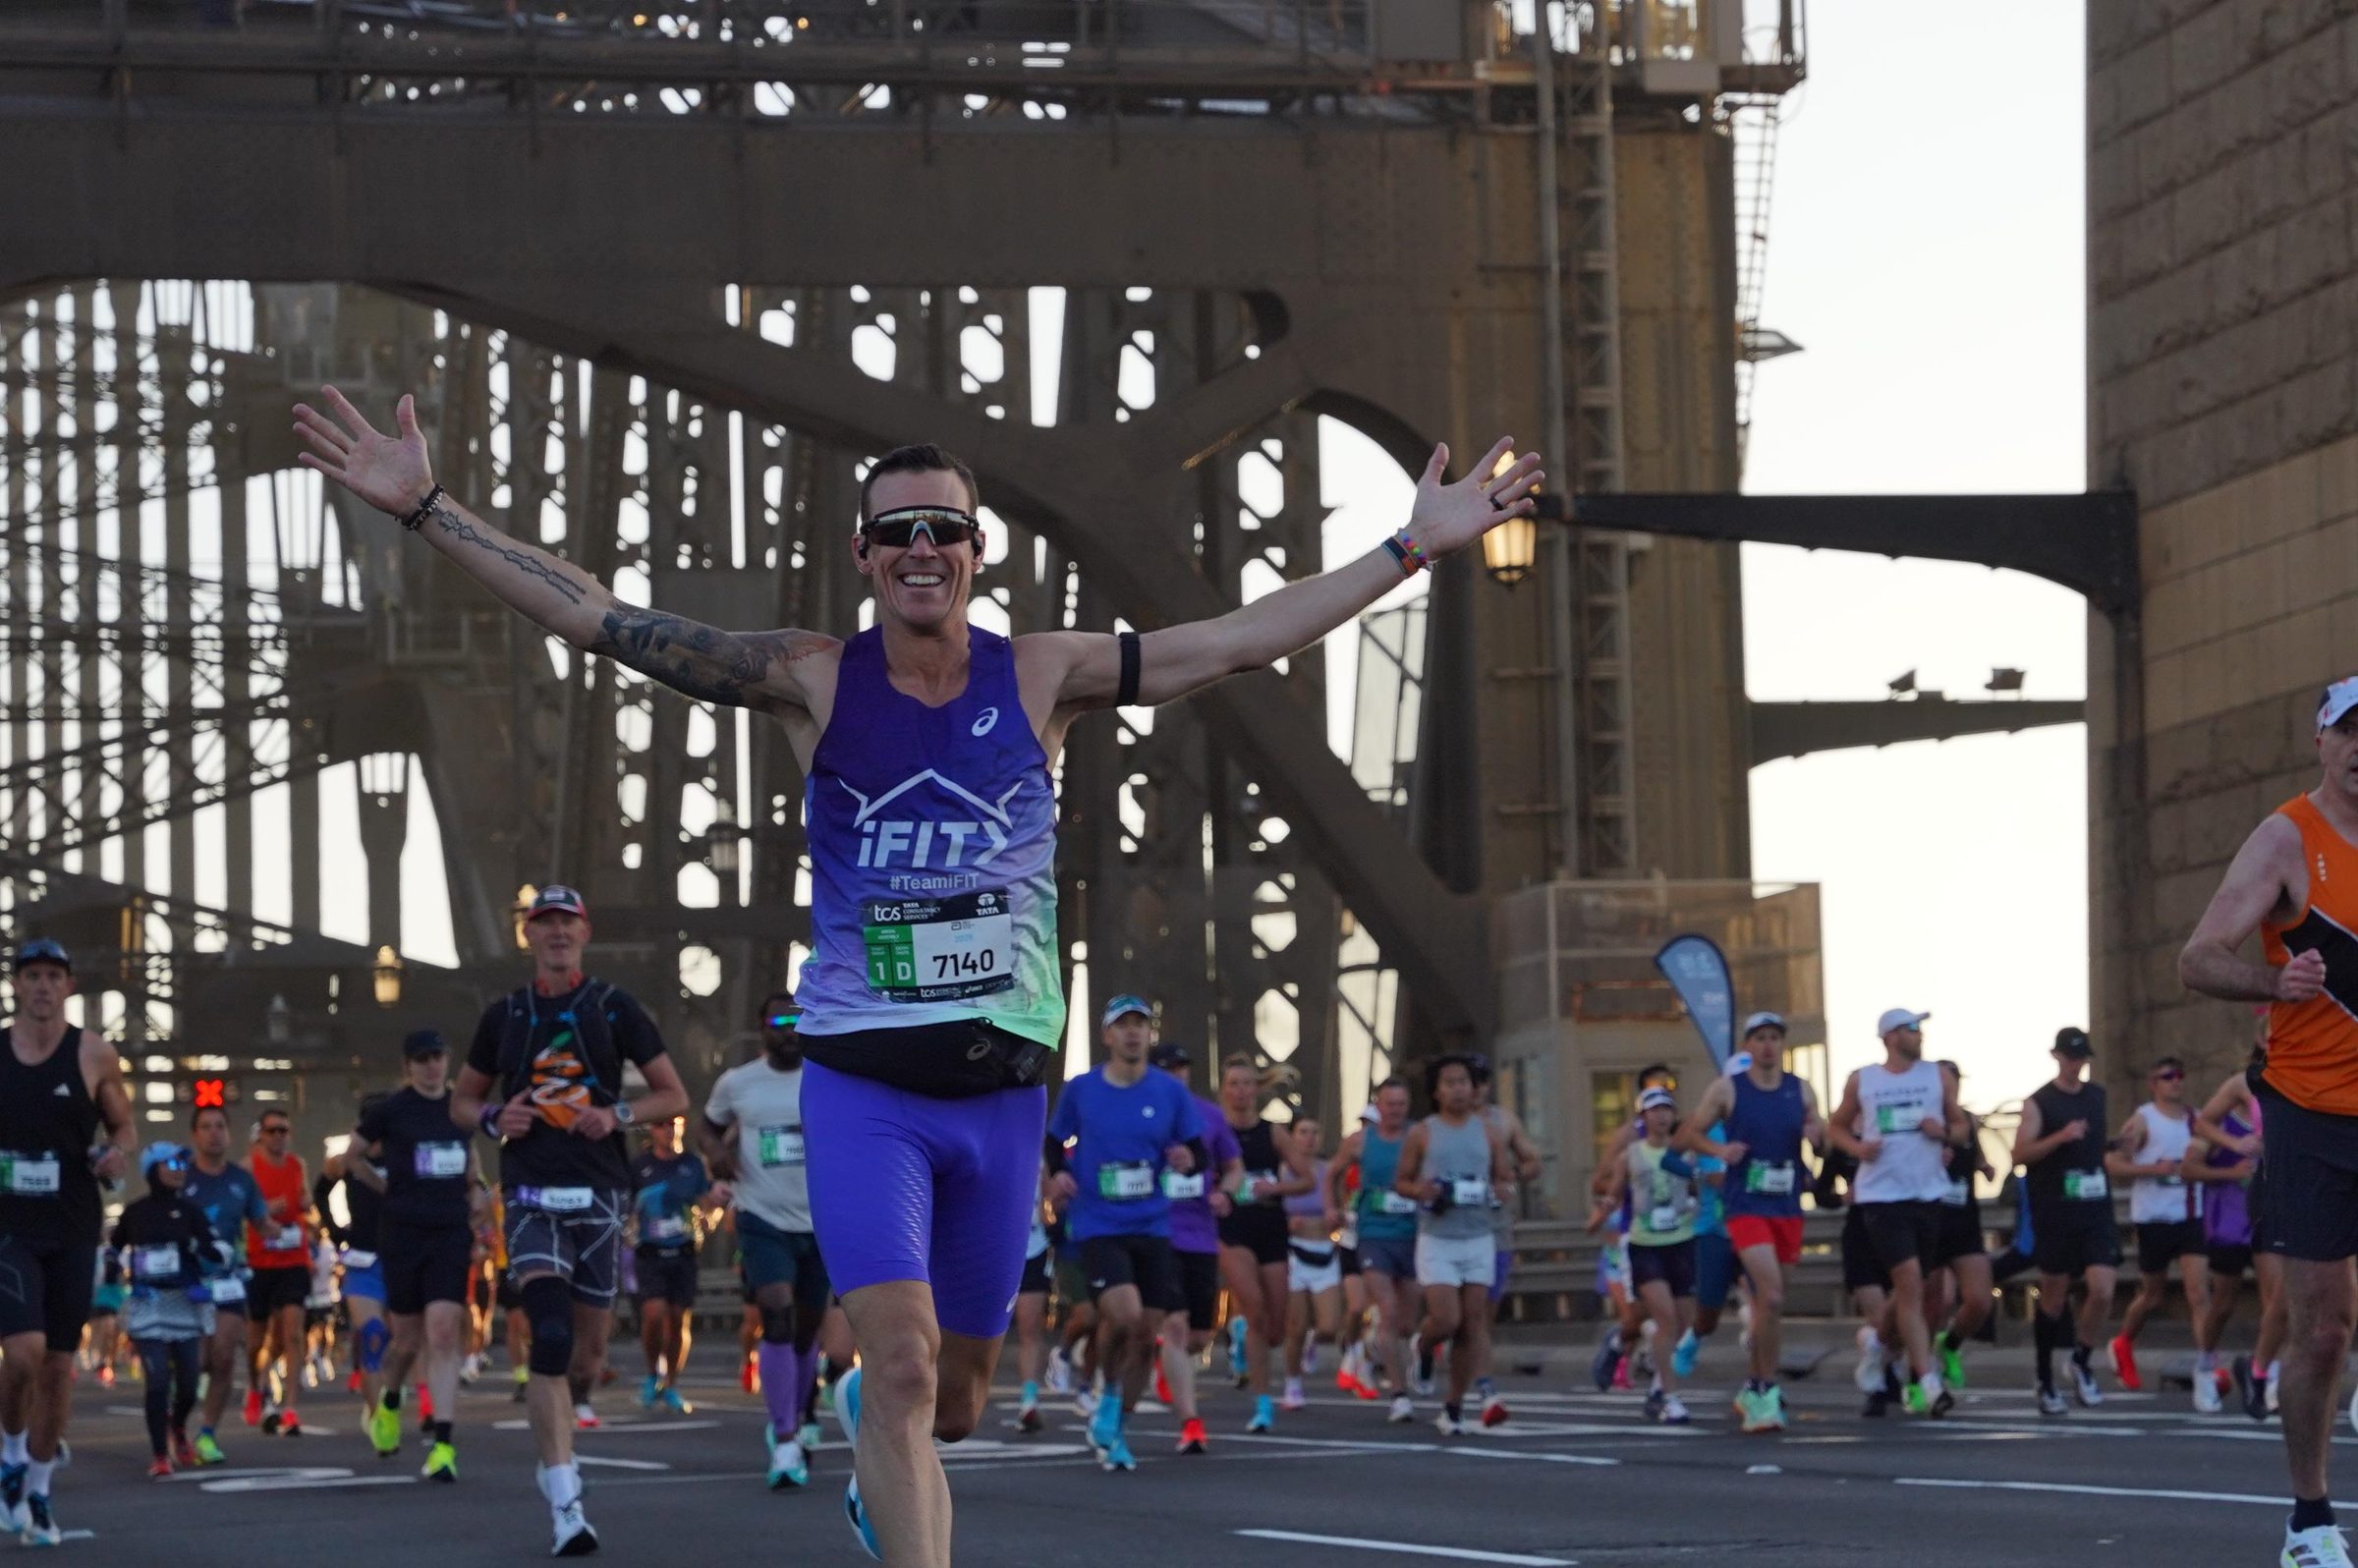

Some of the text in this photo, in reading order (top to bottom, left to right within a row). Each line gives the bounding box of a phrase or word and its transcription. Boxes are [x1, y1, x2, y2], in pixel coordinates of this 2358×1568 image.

[857, 819, 979, 868] iFIT
[889, 872, 980, 890] #TeamiFIT
[874, 904, 902, 922] tcs
[976, 906, 999, 916] TATA
[875, 962, 885, 980] 1
[896, 962, 912, 980] D
[933, 949, 993, 979] 7140
